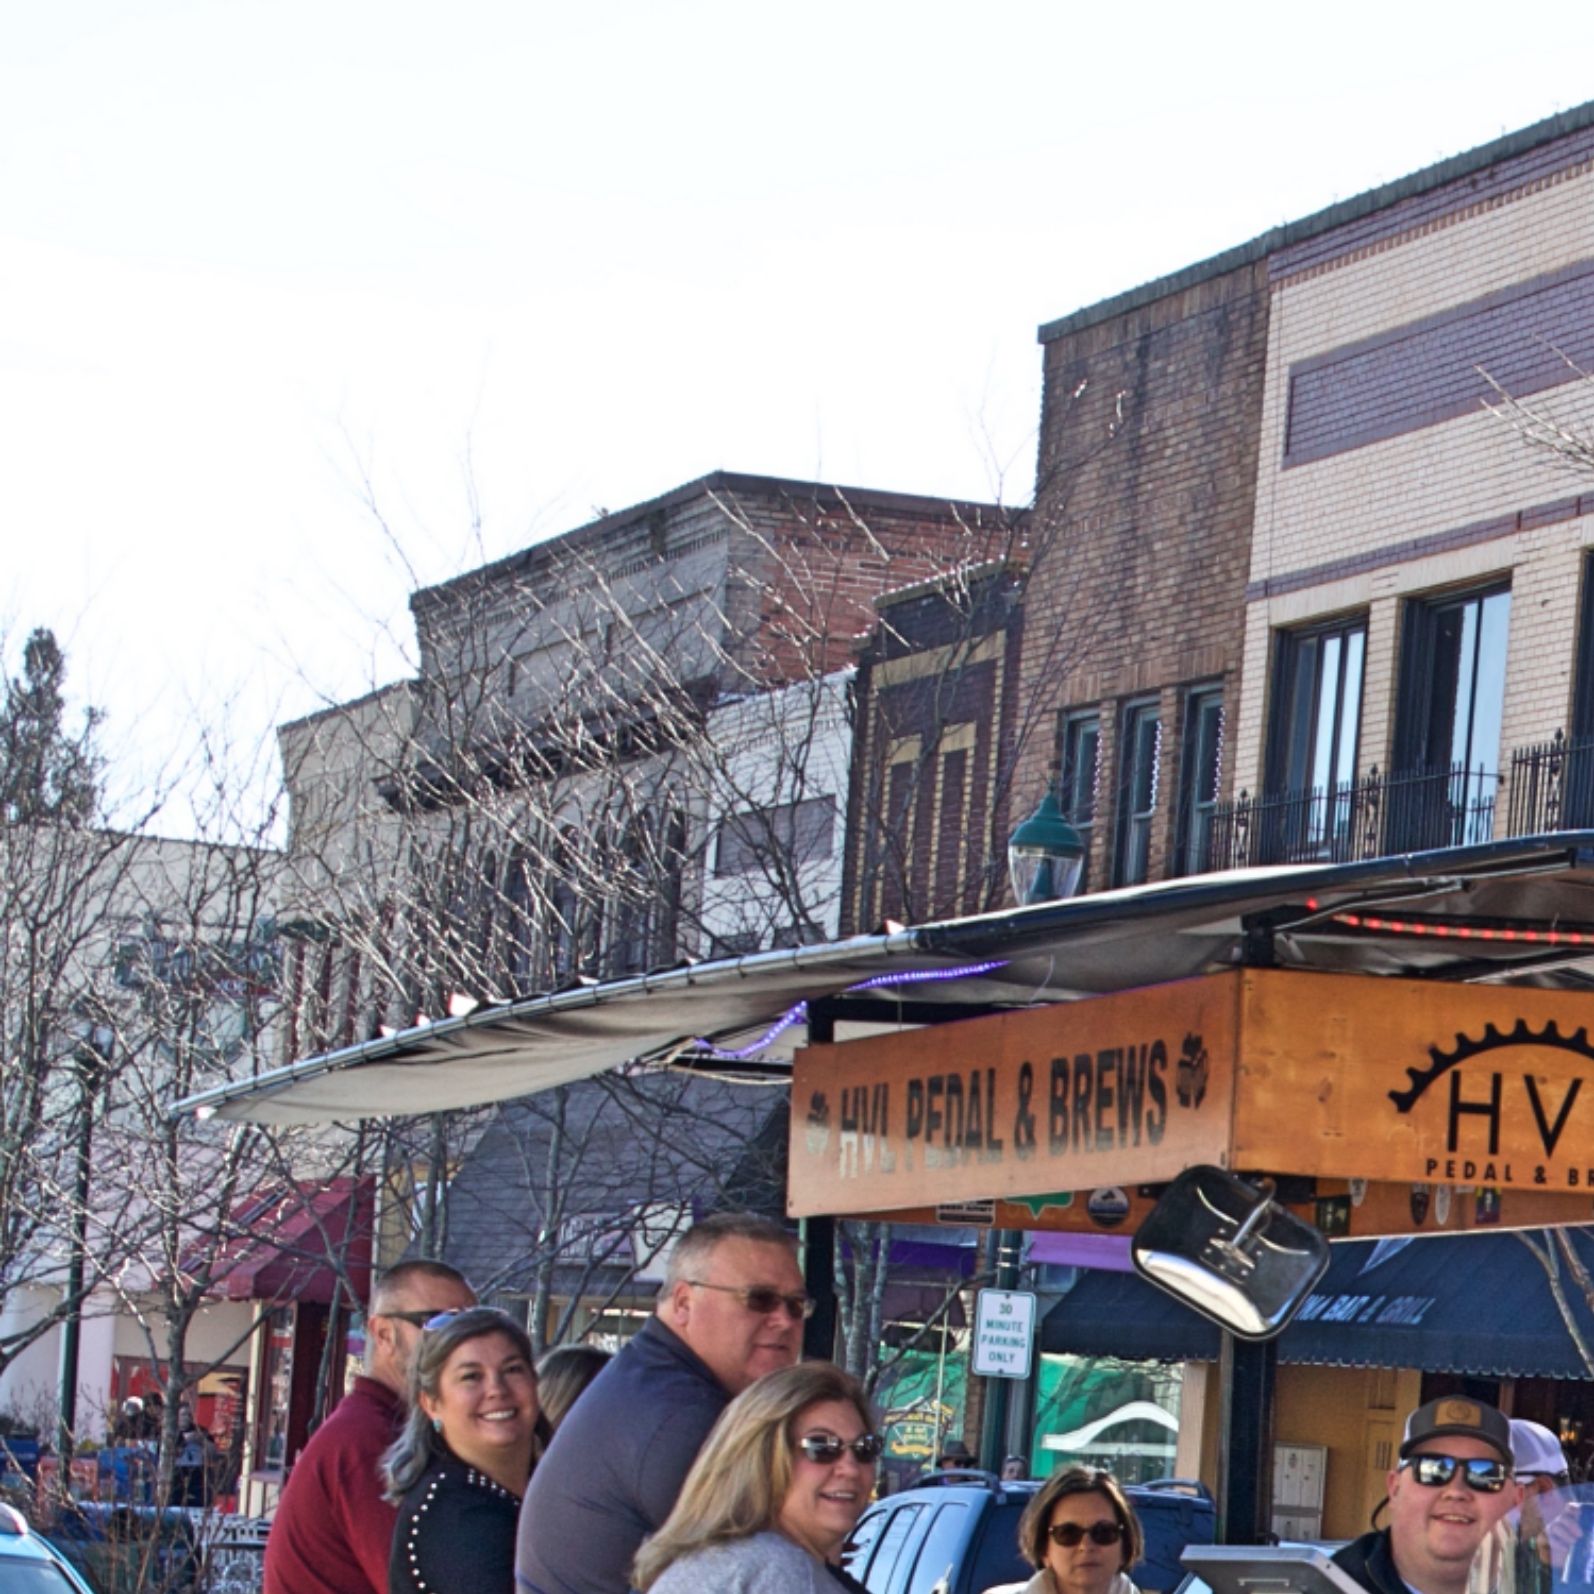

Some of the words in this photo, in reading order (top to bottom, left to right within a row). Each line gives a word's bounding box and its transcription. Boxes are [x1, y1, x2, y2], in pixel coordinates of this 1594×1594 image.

[839, 1083, 896, 1179] HVL
[906, 1067, 1004, 1172] PEDAL
[1014, 1061, 1038, 1161] &
[1049, 1039, 1169, 1158] BREWS
[1426, 1158, 1513, 1182] PEDAL
[1533, 1165, 1547, 1185] &
[999, 1302, 1014, 1315] 30
[1320, 1294, 1371, 1321] BAR
[1375, 1296, 1437, 1325] GRILL
[985, 1319, 1024, 1334] MINUTE
[981, 1334, 1026, 1348] PARKING
[988, 1351, 1016, 1364] ONLY
